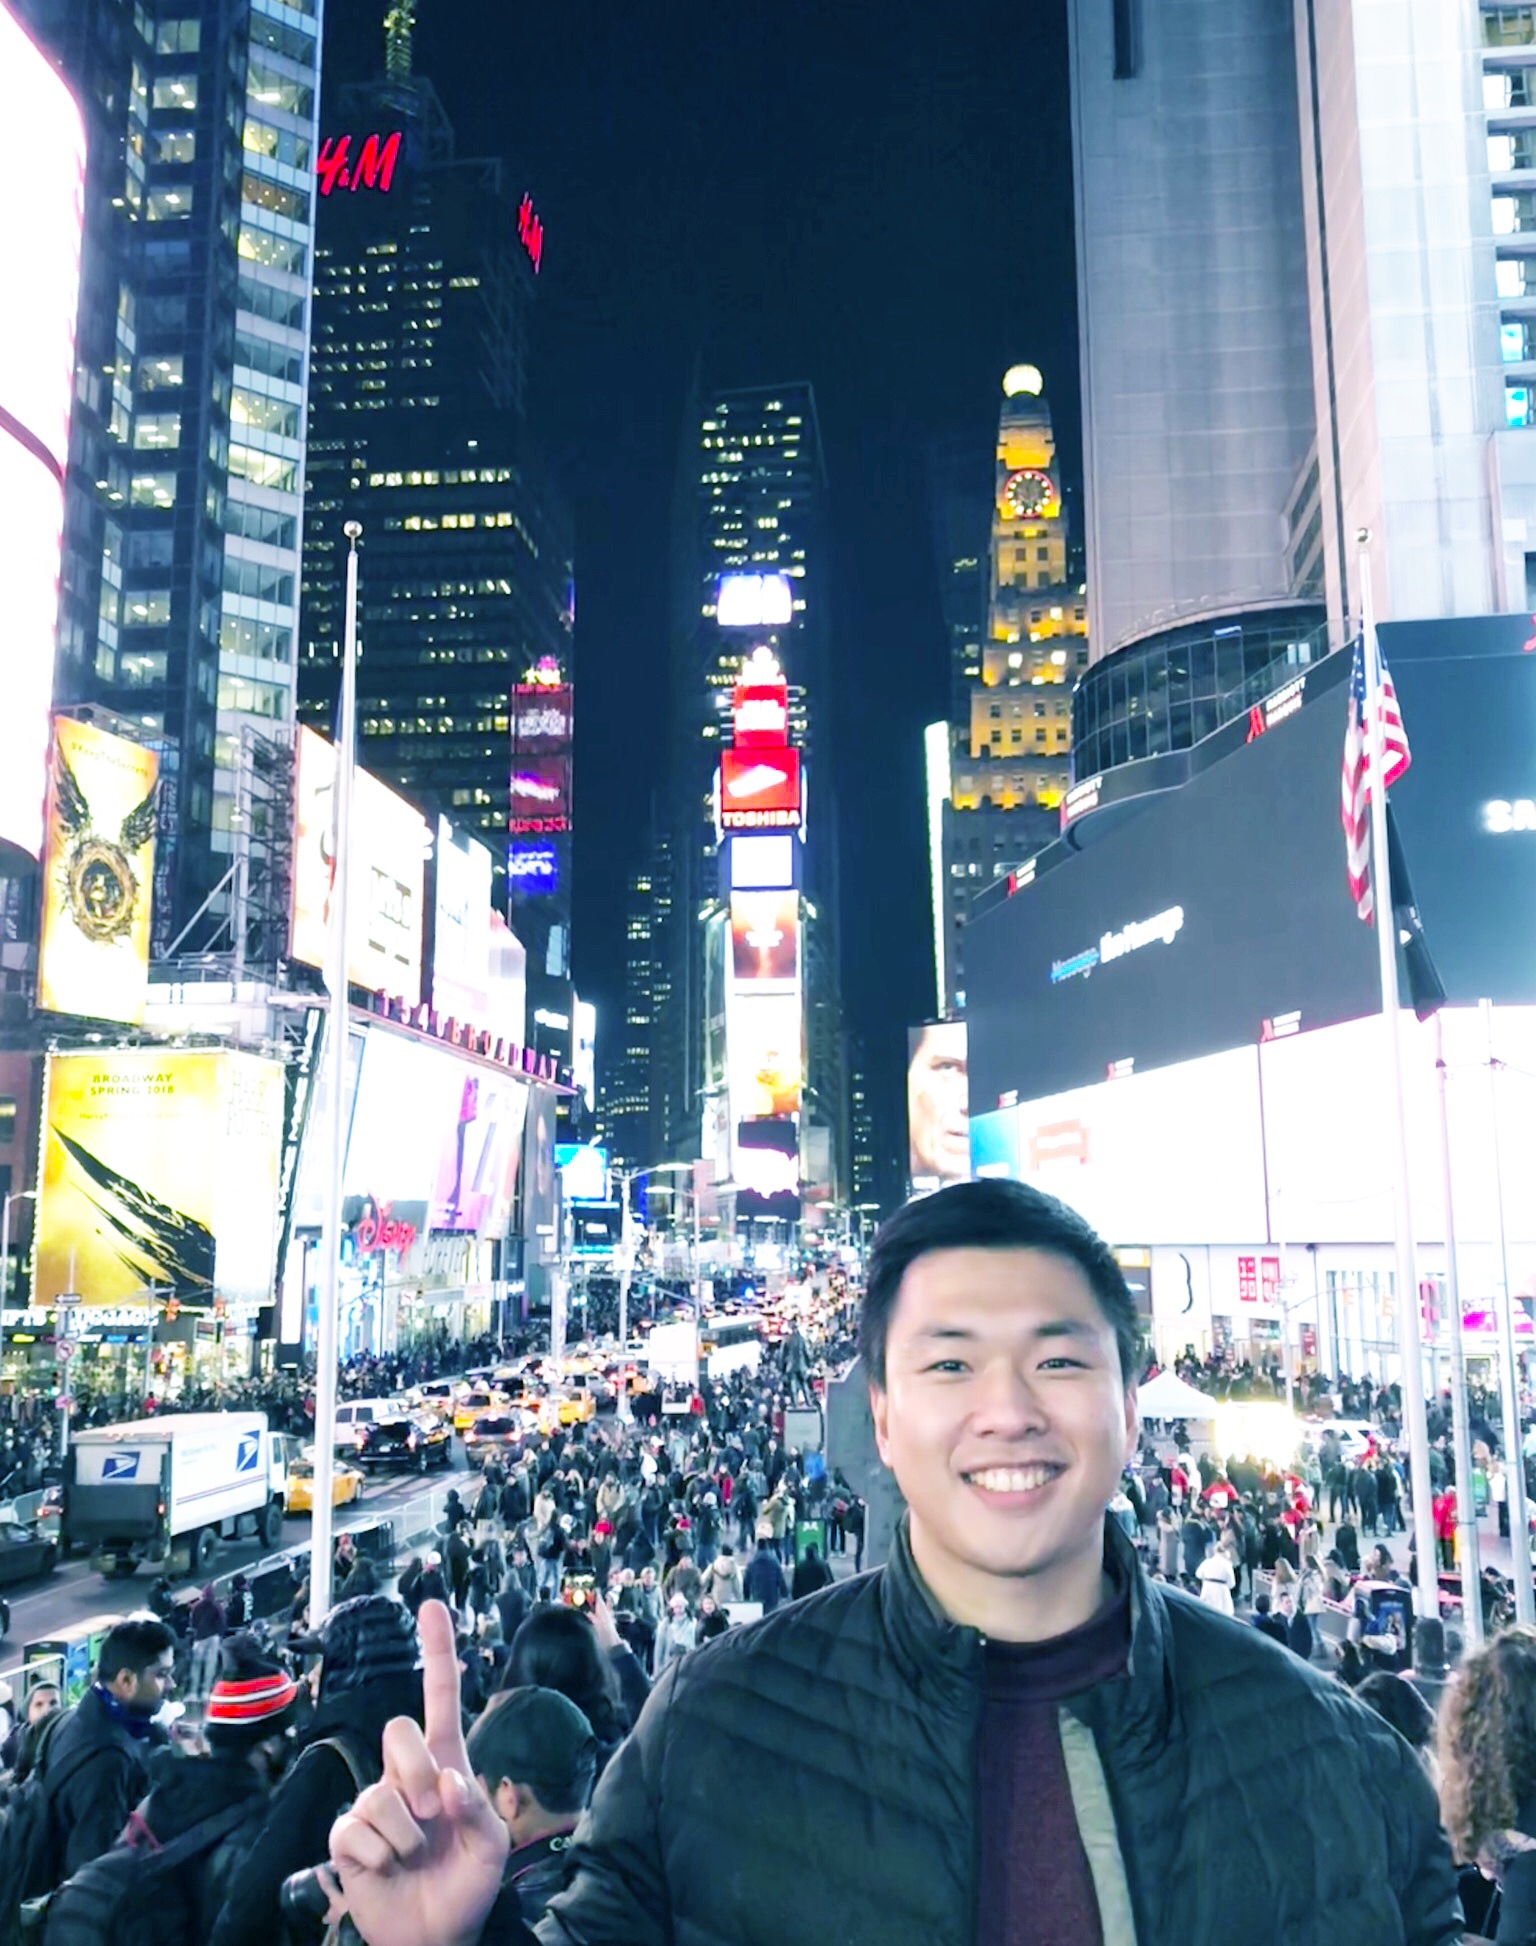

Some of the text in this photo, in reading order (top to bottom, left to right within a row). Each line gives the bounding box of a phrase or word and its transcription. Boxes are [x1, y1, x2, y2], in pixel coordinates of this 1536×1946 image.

[317, 131, 402, 196] H&M
[722, 810, 801, 827] TOSHIBA
[93, 1073, 173, 1083] BROADWAY
[90, 1085, 175, 1096] SPRING 2018
